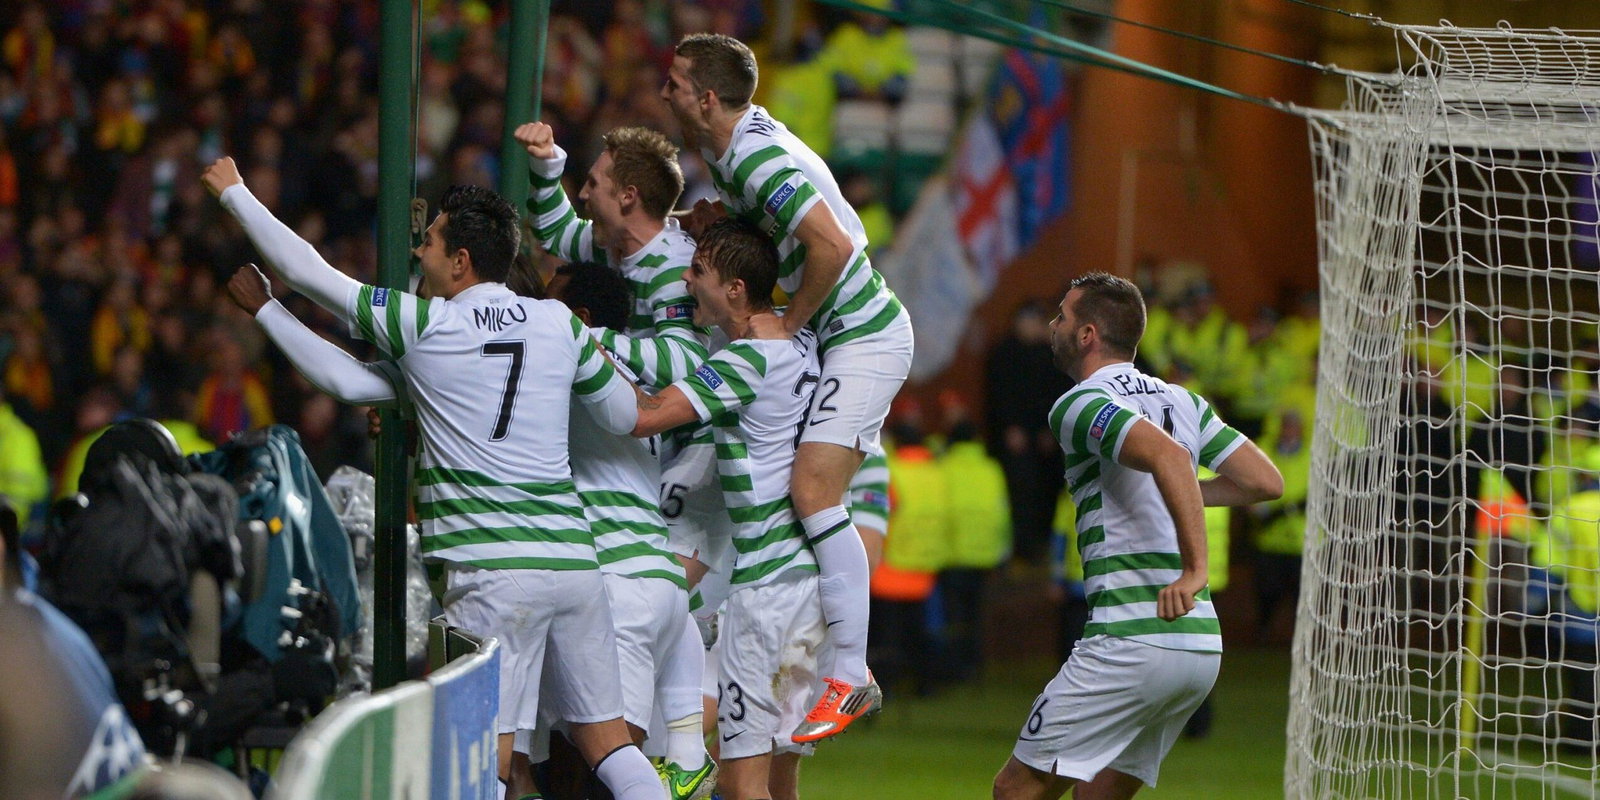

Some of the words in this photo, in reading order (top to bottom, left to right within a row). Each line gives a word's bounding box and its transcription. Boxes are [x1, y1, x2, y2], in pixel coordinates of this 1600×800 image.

[472, 303, 527, 332] MIKU
[480, 338, 526, 442] 7
[818, 377, 841, 412] 2
